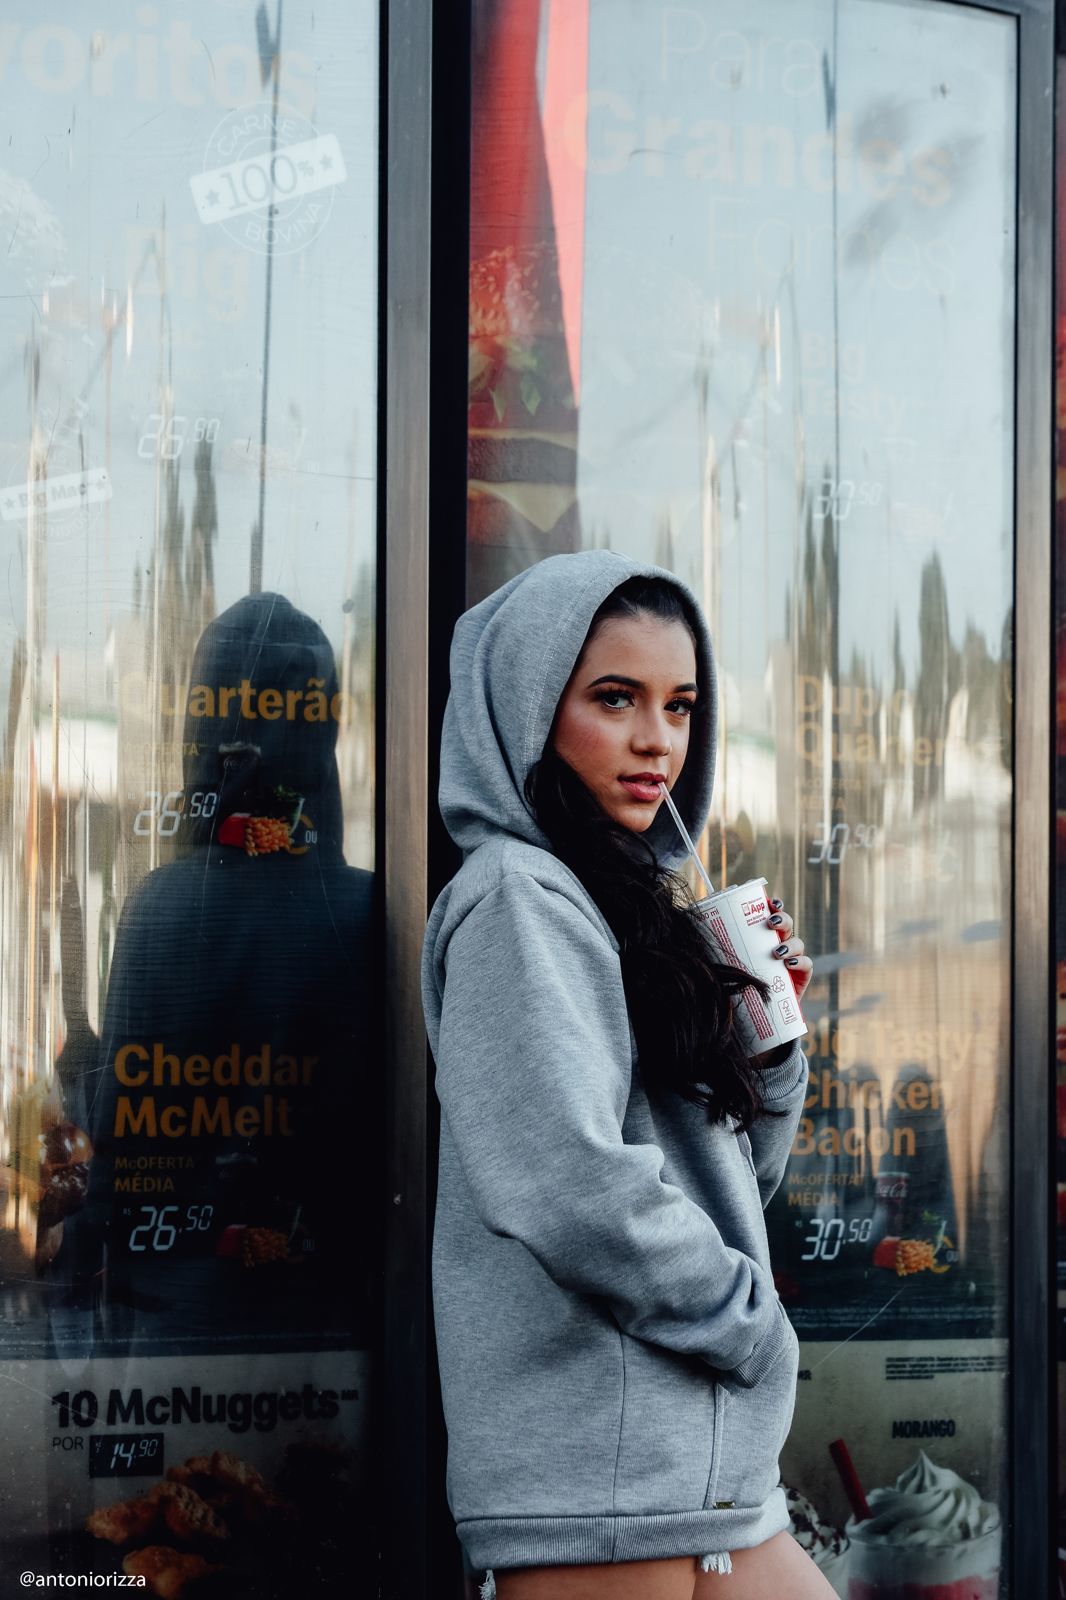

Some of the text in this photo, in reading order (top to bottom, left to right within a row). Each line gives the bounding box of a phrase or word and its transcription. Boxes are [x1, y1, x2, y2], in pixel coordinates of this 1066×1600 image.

[661, 8, 820, 96] Para
[217, 113, 297, 156] CARNE
[564, 91, 952, 206] Grandes
[220, 154, 315, 211] 100%
[246, 203, 324, 244] BOVINA
[797, 673, 913, 727] Dupo
[751, 902, 765, 914] App
[114, 1043, 319, 1087] Cheddar
[113, 1095, 296, 1138] McMelt
[789, 1117, 916, 1157] Bacon
[114, 1156, 195, 1170] McOFERTA
[114, 1172, 175, 1193] MÉDIA
[51, 1390, 98, 1428] 10
[106, 1384, 340, 1433] McNuggets
[892, 1419, 956, 1439] MORANGO
[52, 1436, 85, 1450] POR
